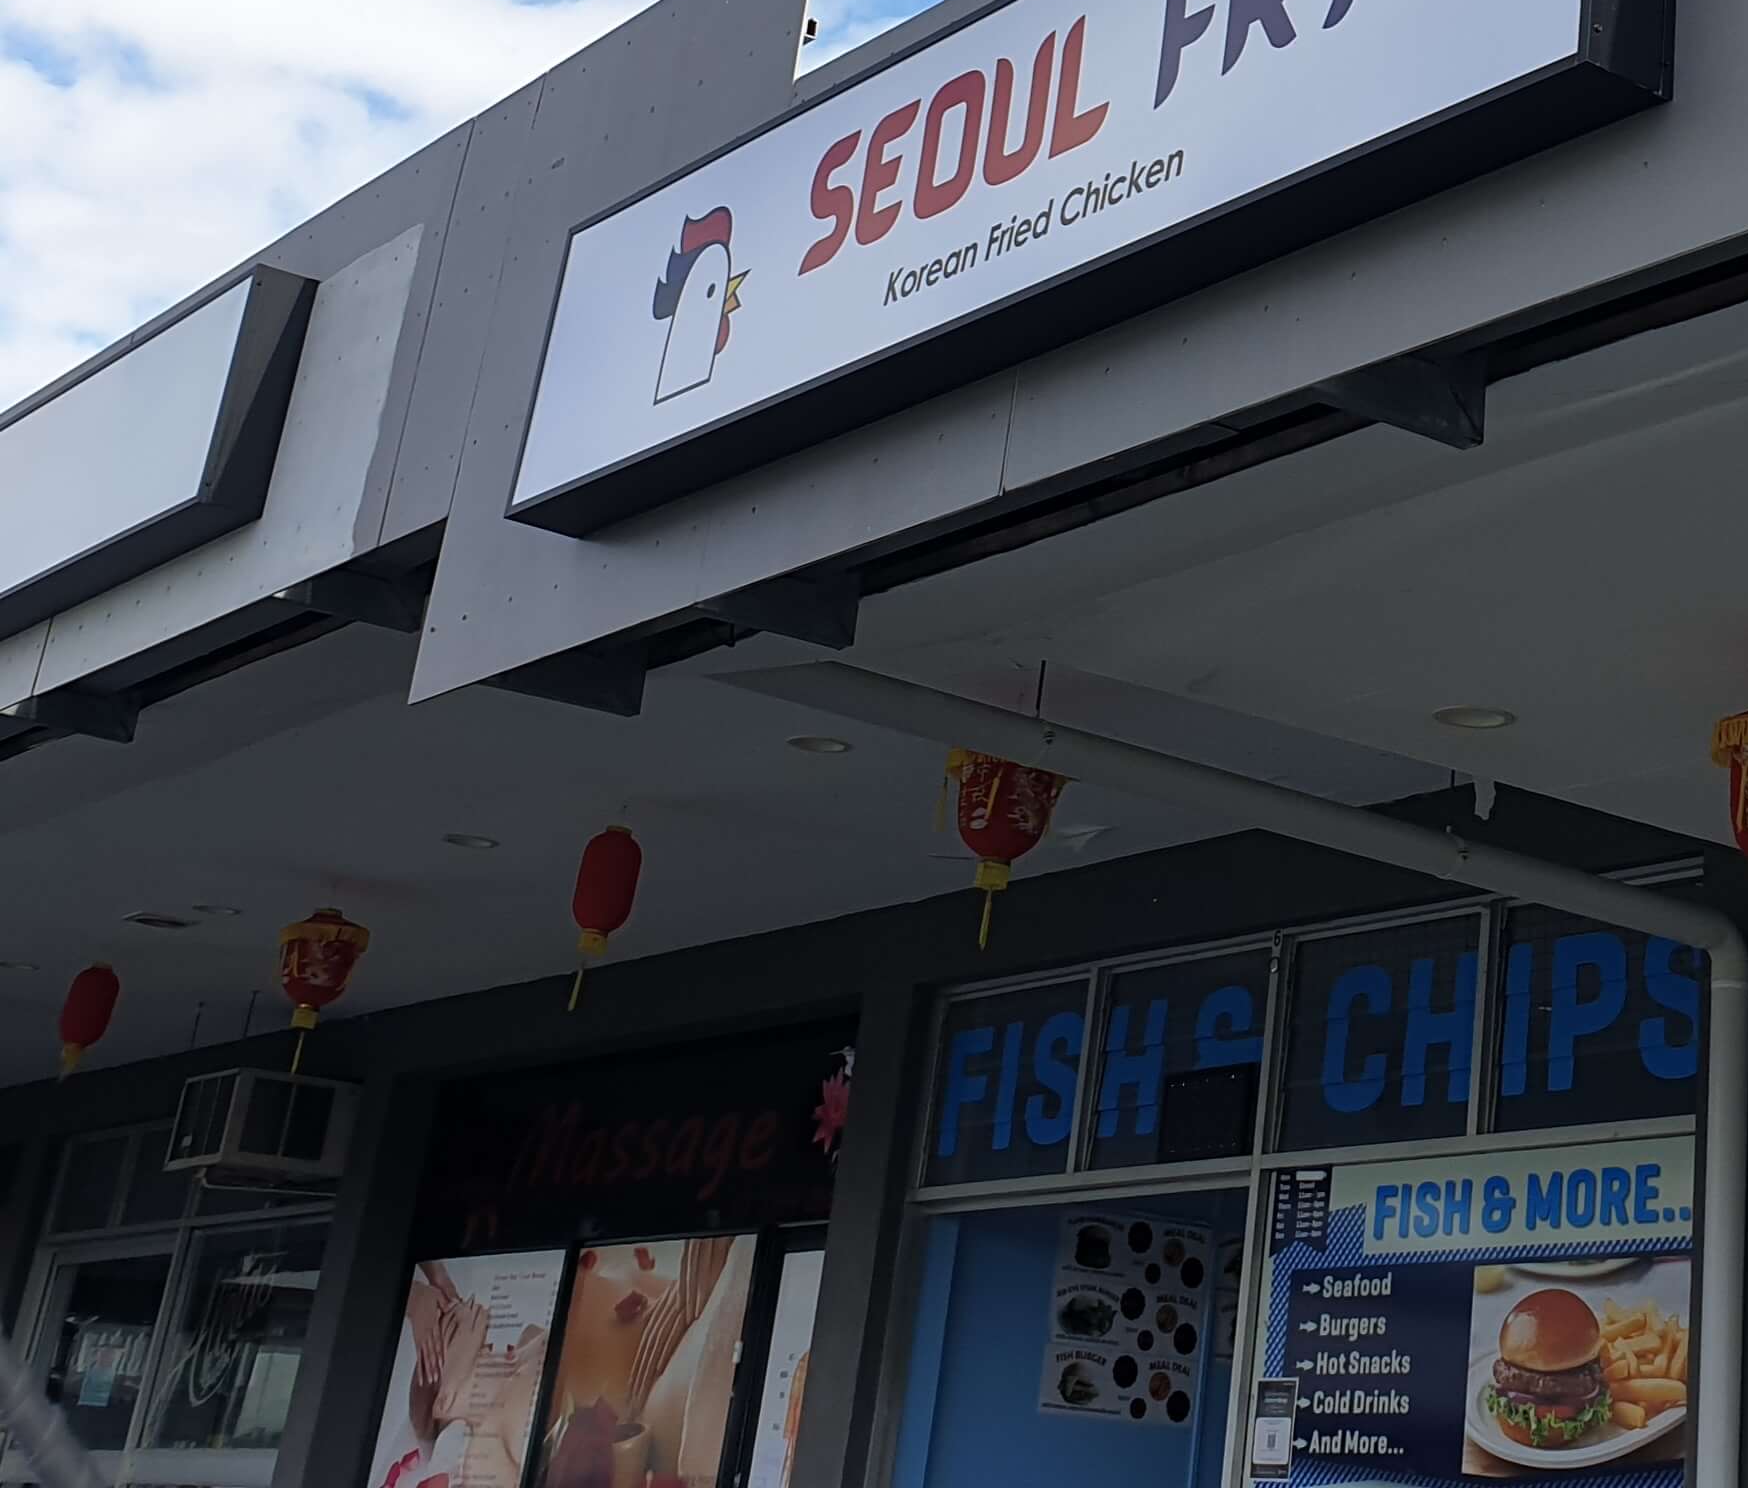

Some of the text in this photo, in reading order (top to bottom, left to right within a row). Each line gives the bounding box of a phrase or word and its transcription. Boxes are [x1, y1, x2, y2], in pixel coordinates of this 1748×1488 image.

[798, 13, 1109, 276] SEOUL
[882, 149, 1184, 307] Korean Fried Chicken
[937, 996, 1168, 1159] FISH
[1321, 930, 1700, 1115] CHIPS
[512, 1100, 778, 1200] Massage
[1373, 1178, 1474, 1241] FISH
[1481, 1174, 1516, 1234] &
[1524, 1163, 1692, 1230] MORE..
[1322, 1271, 1392, 1299] Seafood
[1319, 1313, 1386, 1341] Burgers
[1056, 1350, 1107, 1366] FISH BURGER
[1315, 1349, 1411, 1375] Hot Snacks
[1313, 1389, 1351, 1415] Cold
[1353, 1388, 1410, 1415] Drinks
[1308, 1429, 1405, 1455] And More...
